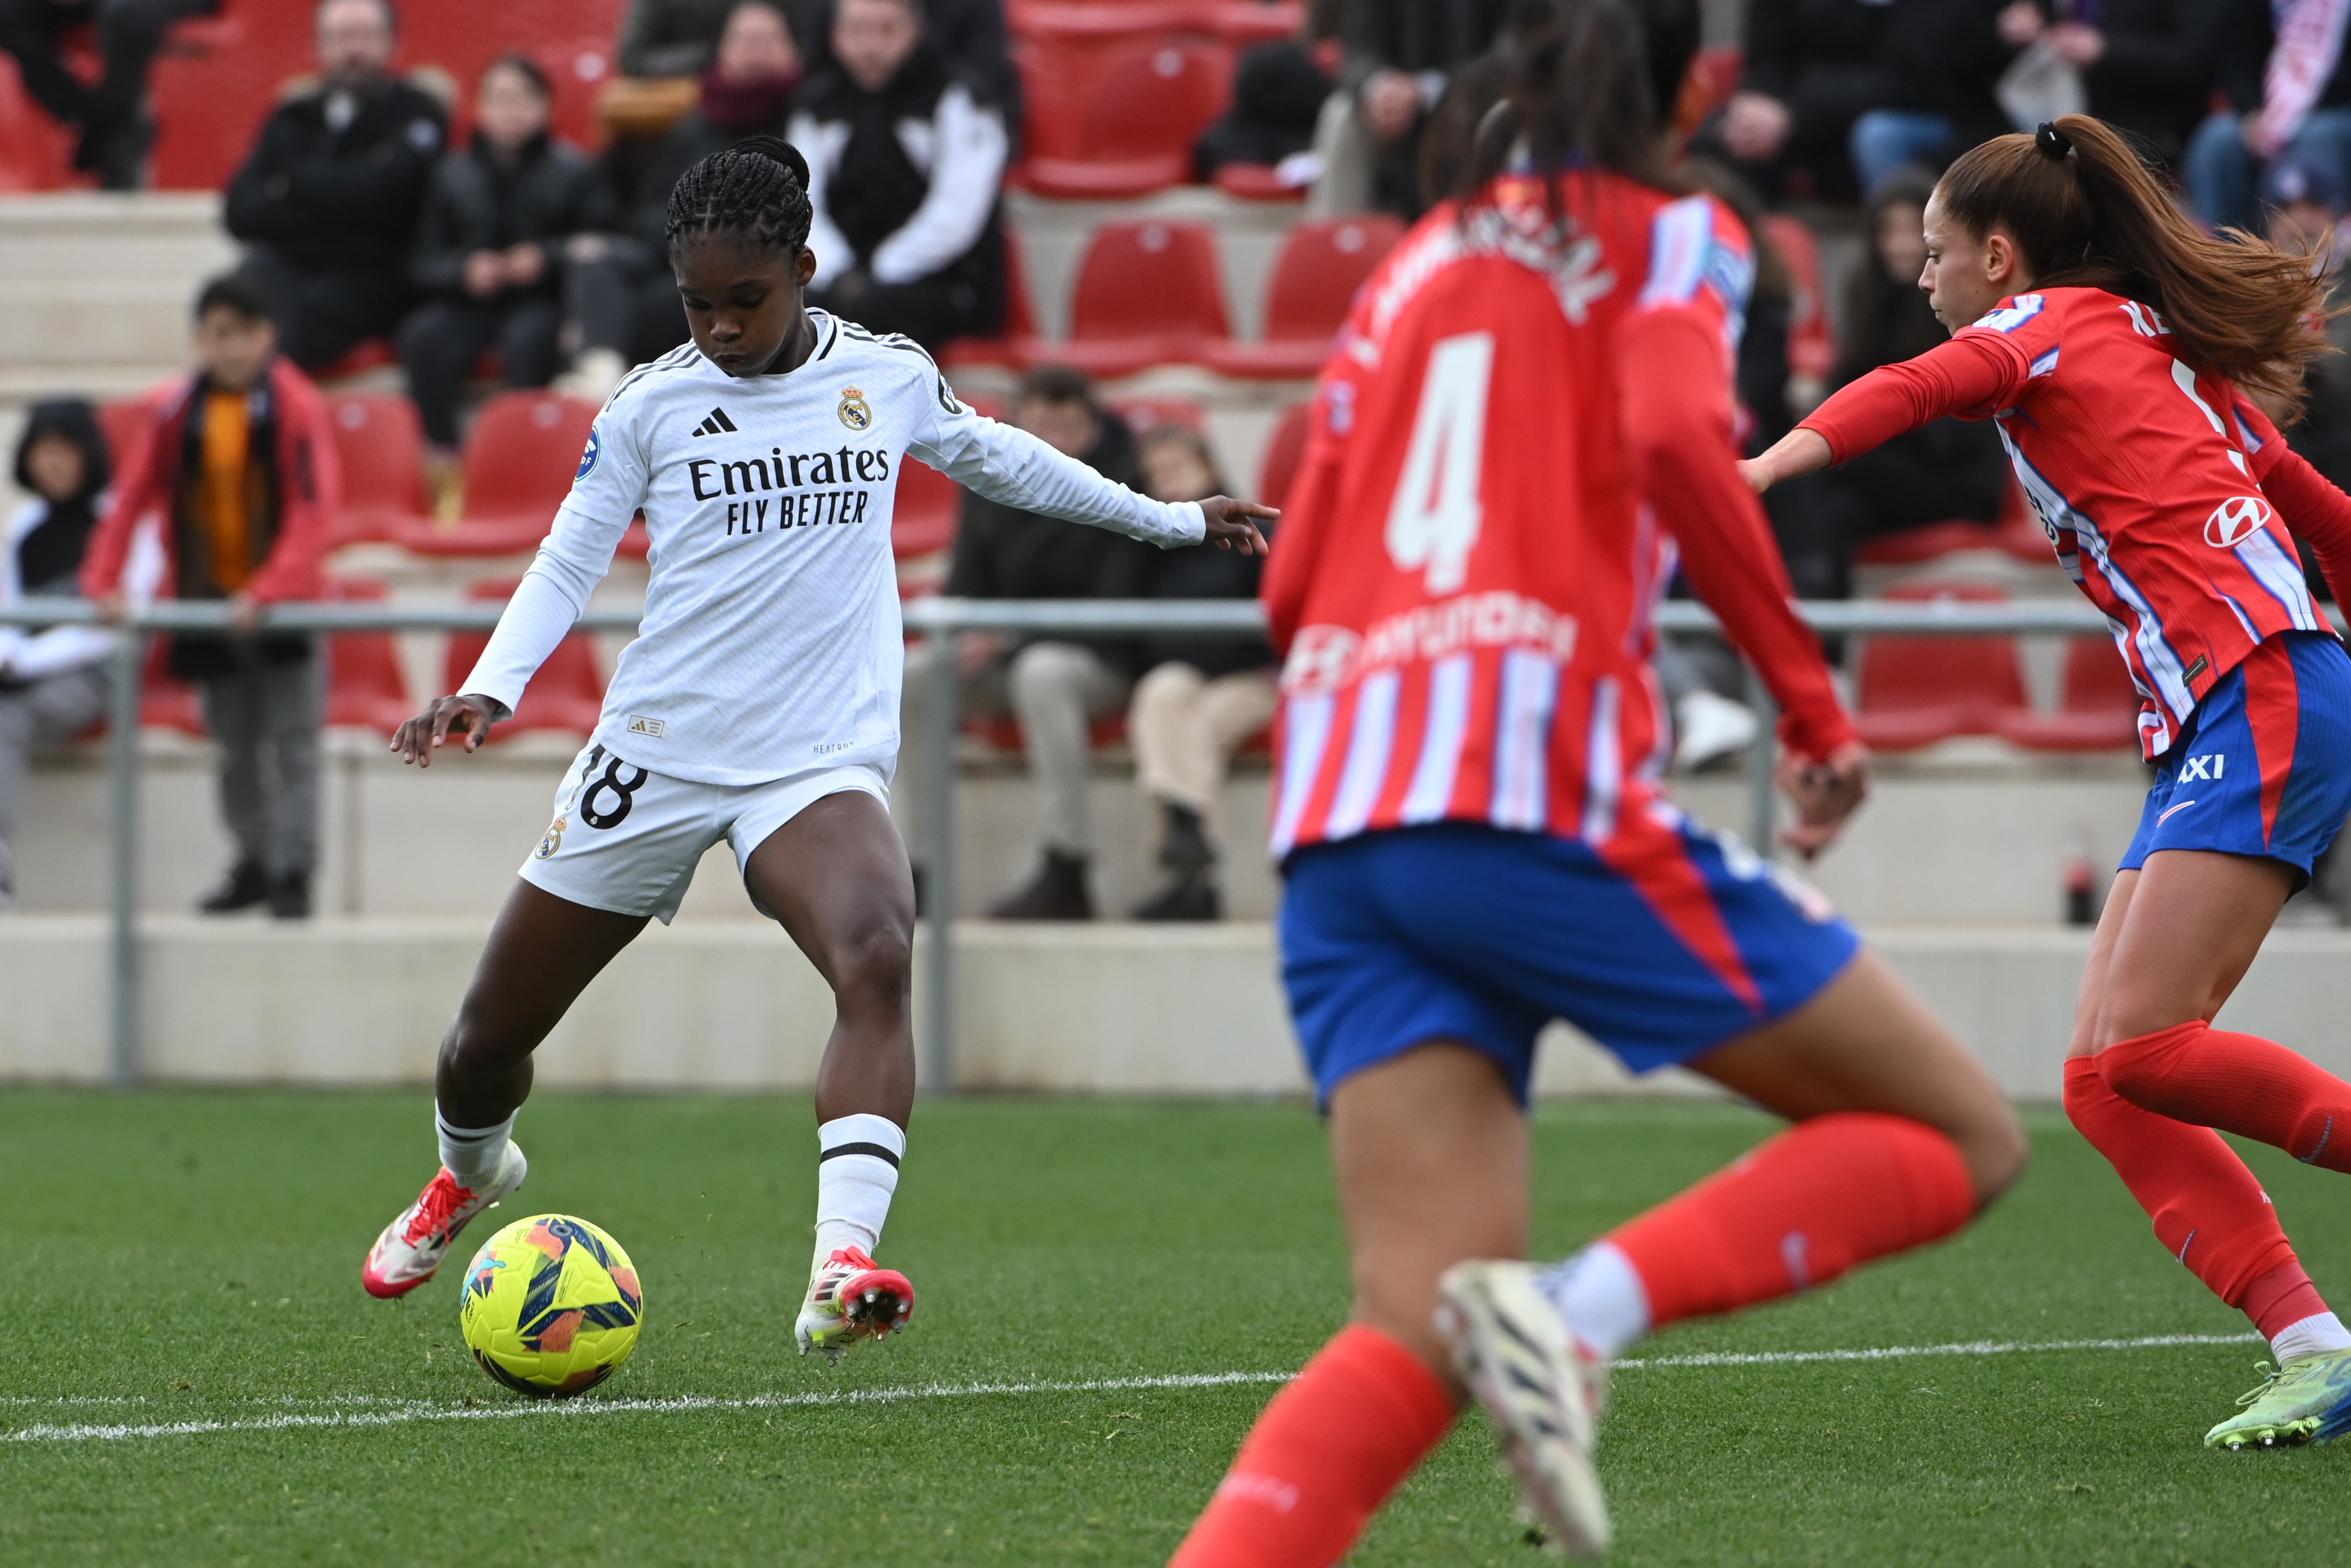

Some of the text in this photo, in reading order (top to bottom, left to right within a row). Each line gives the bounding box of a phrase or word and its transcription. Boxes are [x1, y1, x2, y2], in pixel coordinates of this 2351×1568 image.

[688, 444, 889, 501] Emirates
[1384, 328, 1496, 595] 4
[727, 491, 868, 535] FLY BETTER
[564, 743, 649, 830] 18
